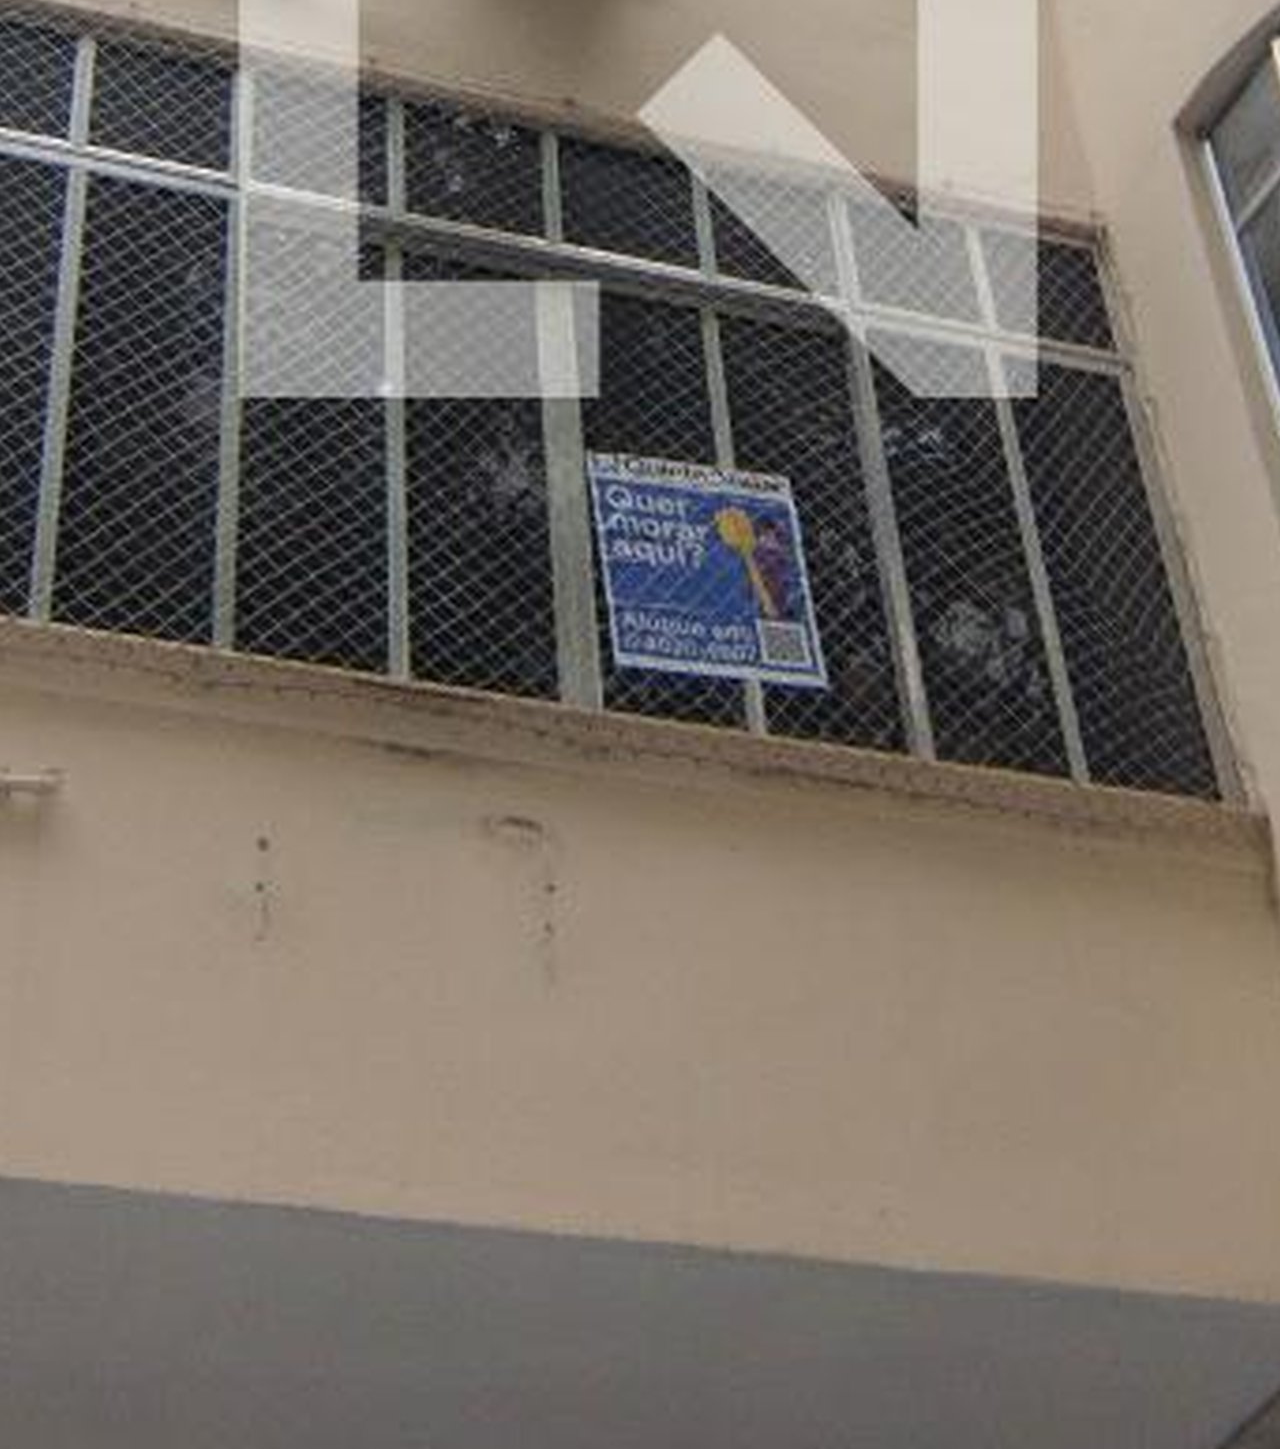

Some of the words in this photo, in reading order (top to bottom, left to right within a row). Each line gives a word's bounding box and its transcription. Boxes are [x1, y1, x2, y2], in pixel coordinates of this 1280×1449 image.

[606, 485, 694, 517] Quer
[606, 514, 709, 541] morar
[611, 540, 706, 568] aqui?
